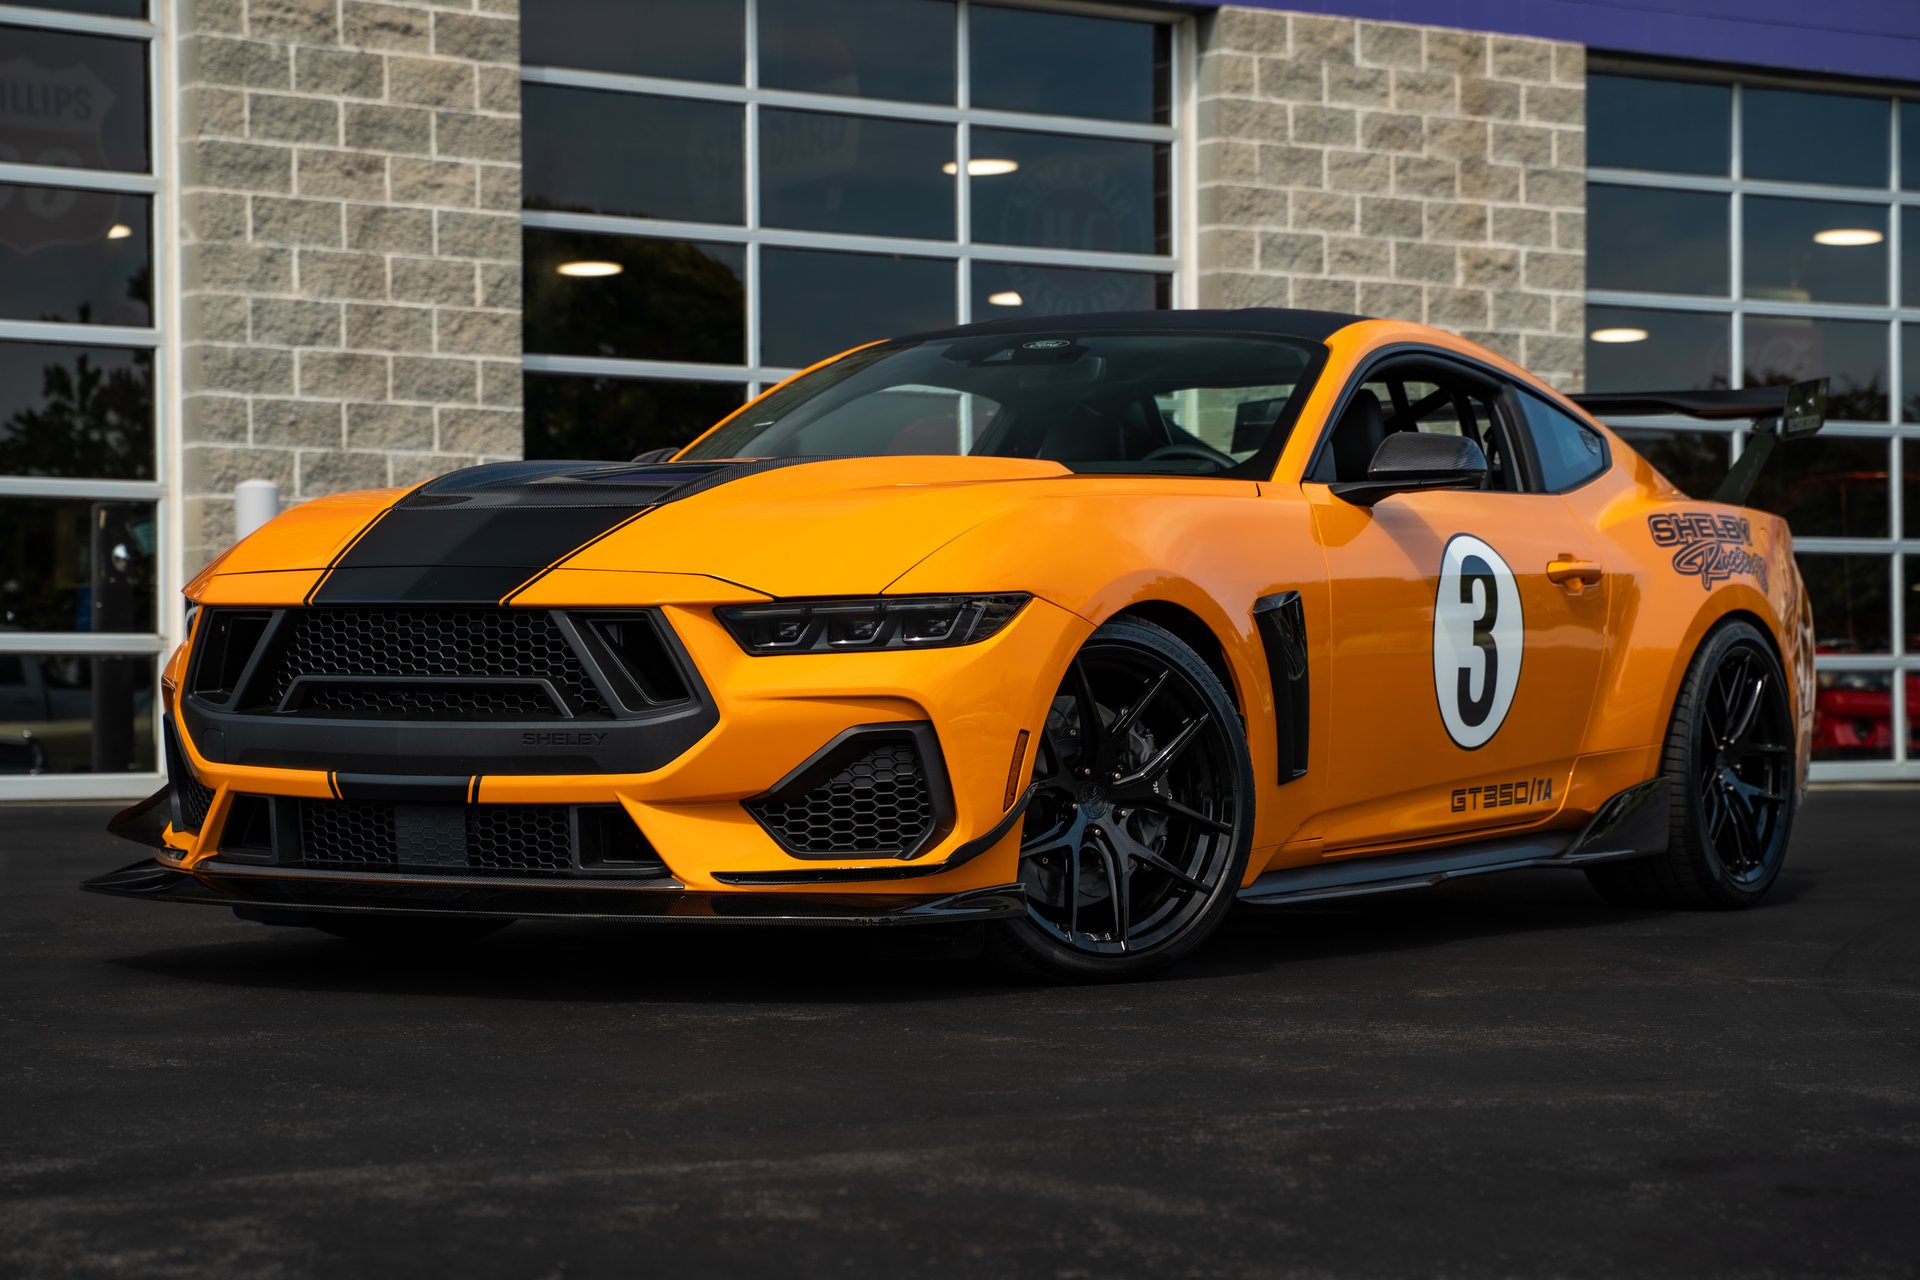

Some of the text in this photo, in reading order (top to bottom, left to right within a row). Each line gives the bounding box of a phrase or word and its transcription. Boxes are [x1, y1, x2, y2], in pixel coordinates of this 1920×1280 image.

[1648, 513, 1752, 546] SHELBY
[1456, 553, 1499, 728] 3
[521, 731, 609, 746] SHELBY
[1451, 777, 1552, 812] GT350/TA
